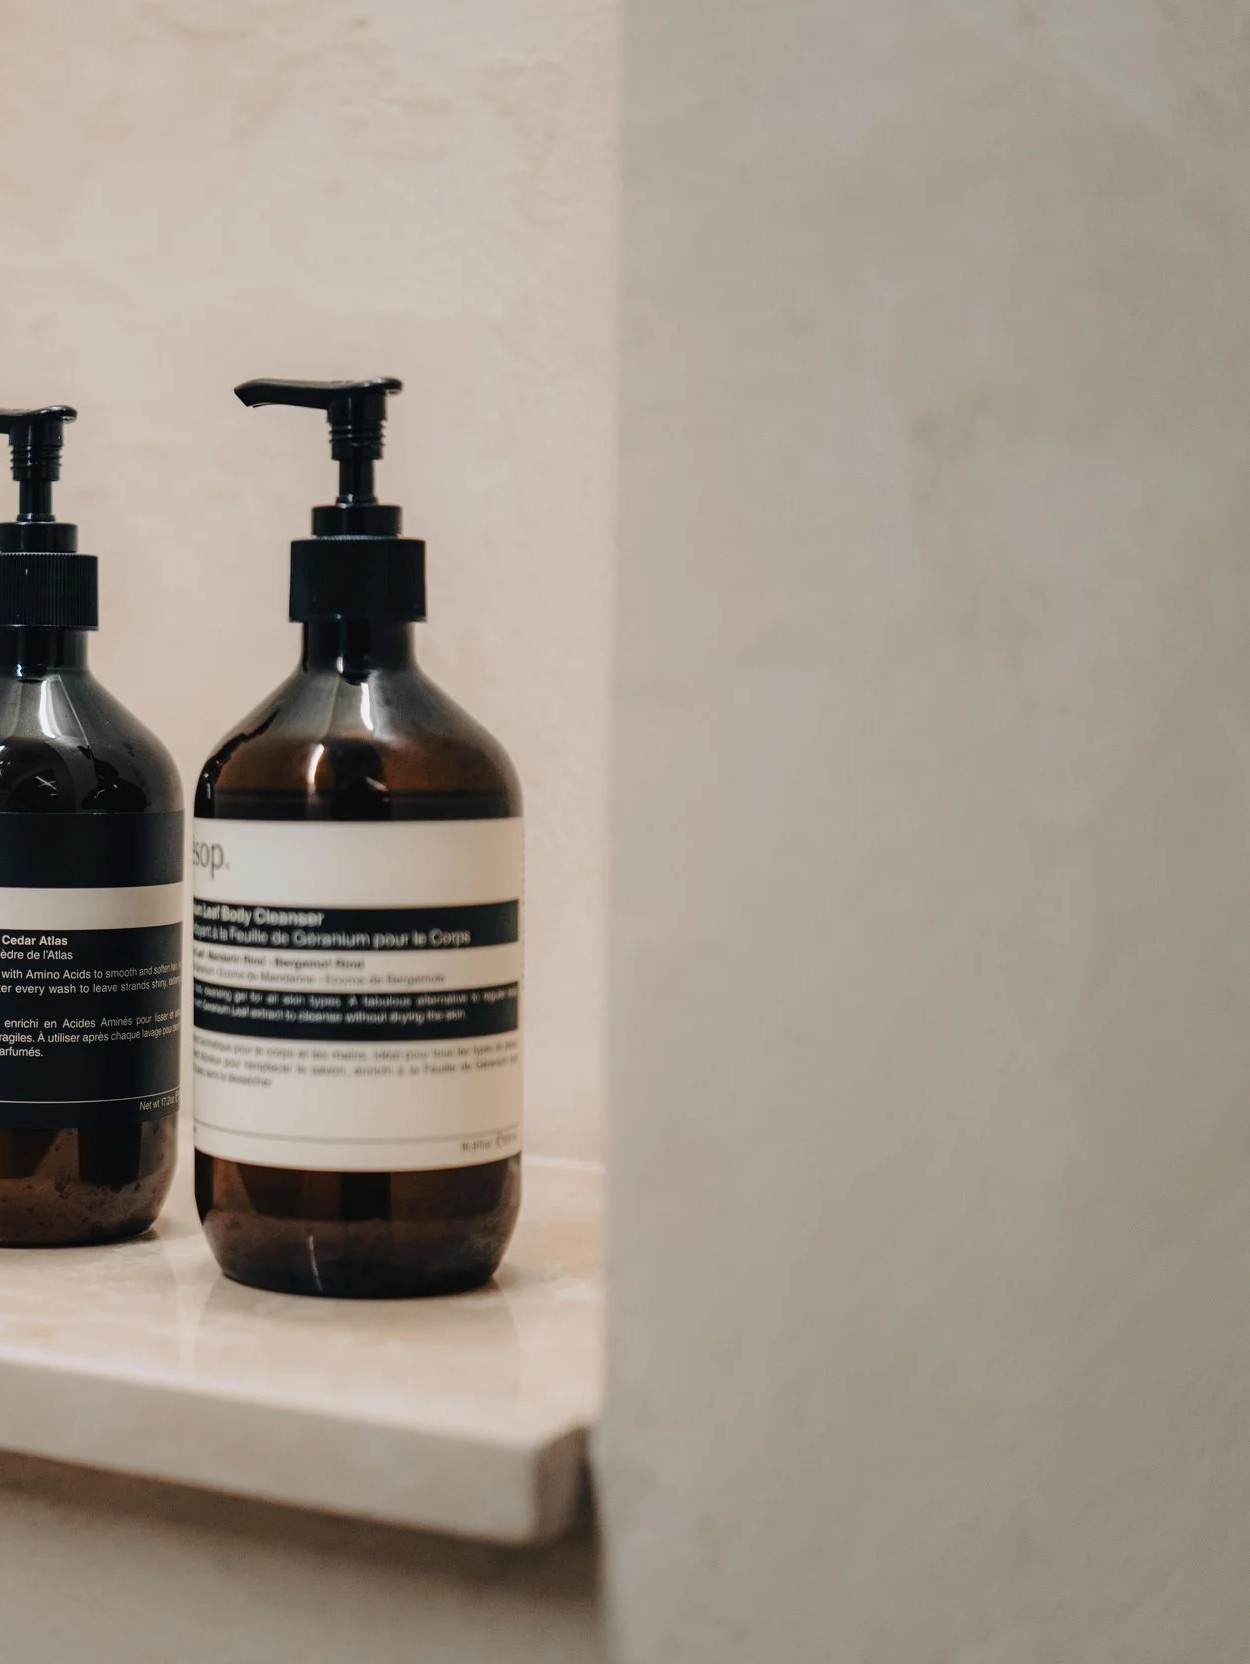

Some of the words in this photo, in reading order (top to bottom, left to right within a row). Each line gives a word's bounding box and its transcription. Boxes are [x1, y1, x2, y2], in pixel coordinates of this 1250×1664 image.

[221, 905, 252, 927] Body
[253, 907, 325, 927] Cleanser
[1, 934, 37, 946] Cedar
[38, 935, 68, 946] Atlas
[230, 926, 269, 946] Feuille
[271, 929, 290, 946] de
[291, 928, 371, 948] Géranium
[372, 931, 409, 950] pour
[410, 929, 427, 946] le
[428, 928, 472, 948] Corps
[26, 950, 40, 960] de
[43, 950, 74, 960] l'Atlas
[1, 968, 23, 979] with
[25, 969, 60, 980] Amino
[62, 969, 91, 980] Acids
[93, 969, 104, 979] to
[105, 966, 138, 979] smooth
[138, 965, 153, 977] and
[15, 985, 45, 996] every
[48, 984, 77, 994] wash
[79, 984, 90, 994] to
[93, 983, 118, 993] leave
[120, 981, 150, 993] strands
[4, 1018, 39, 1029] enrichi
[43, 1019, 57, 1029] en
[62, 1018, 96, 1029] Acides
[100, 1017, 133, 1028] Aminés
[136, 1014, 152, 1026] pour
[344, 1011, 387, 1024] without
[37, 1030, 46, 1043] À
[48, 1032, 80, 1043] utiliser
[82, 1031, 109, 1044] après
[110, 1030, 141, 1042] chaque
[141, 1025, 162, 1039] lavage
[140, 1100, 152, 1111] Net
